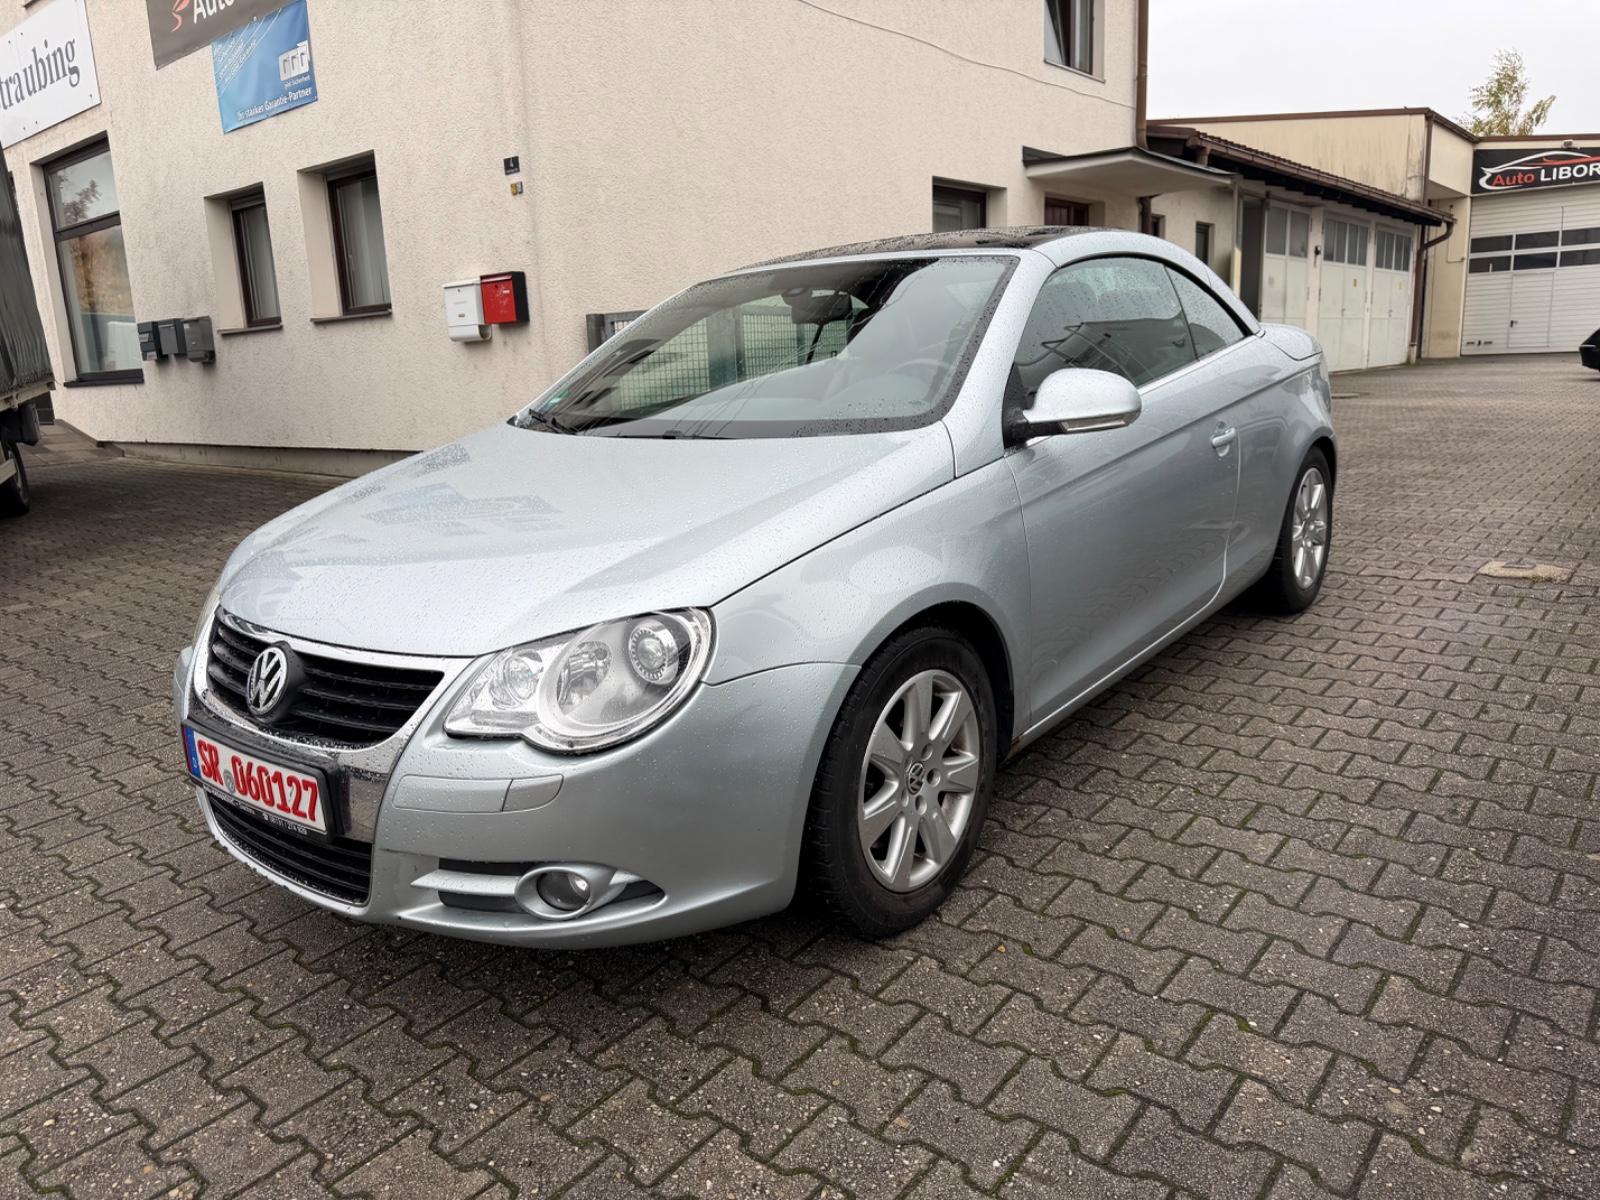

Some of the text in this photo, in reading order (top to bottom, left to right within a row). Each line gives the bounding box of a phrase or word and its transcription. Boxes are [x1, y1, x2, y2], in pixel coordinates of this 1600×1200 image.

[1491, 164, 1600, 187] Auto LIBOR
[197, 739, 224, 786] SR
[231, 755, 319, 822] 060127
